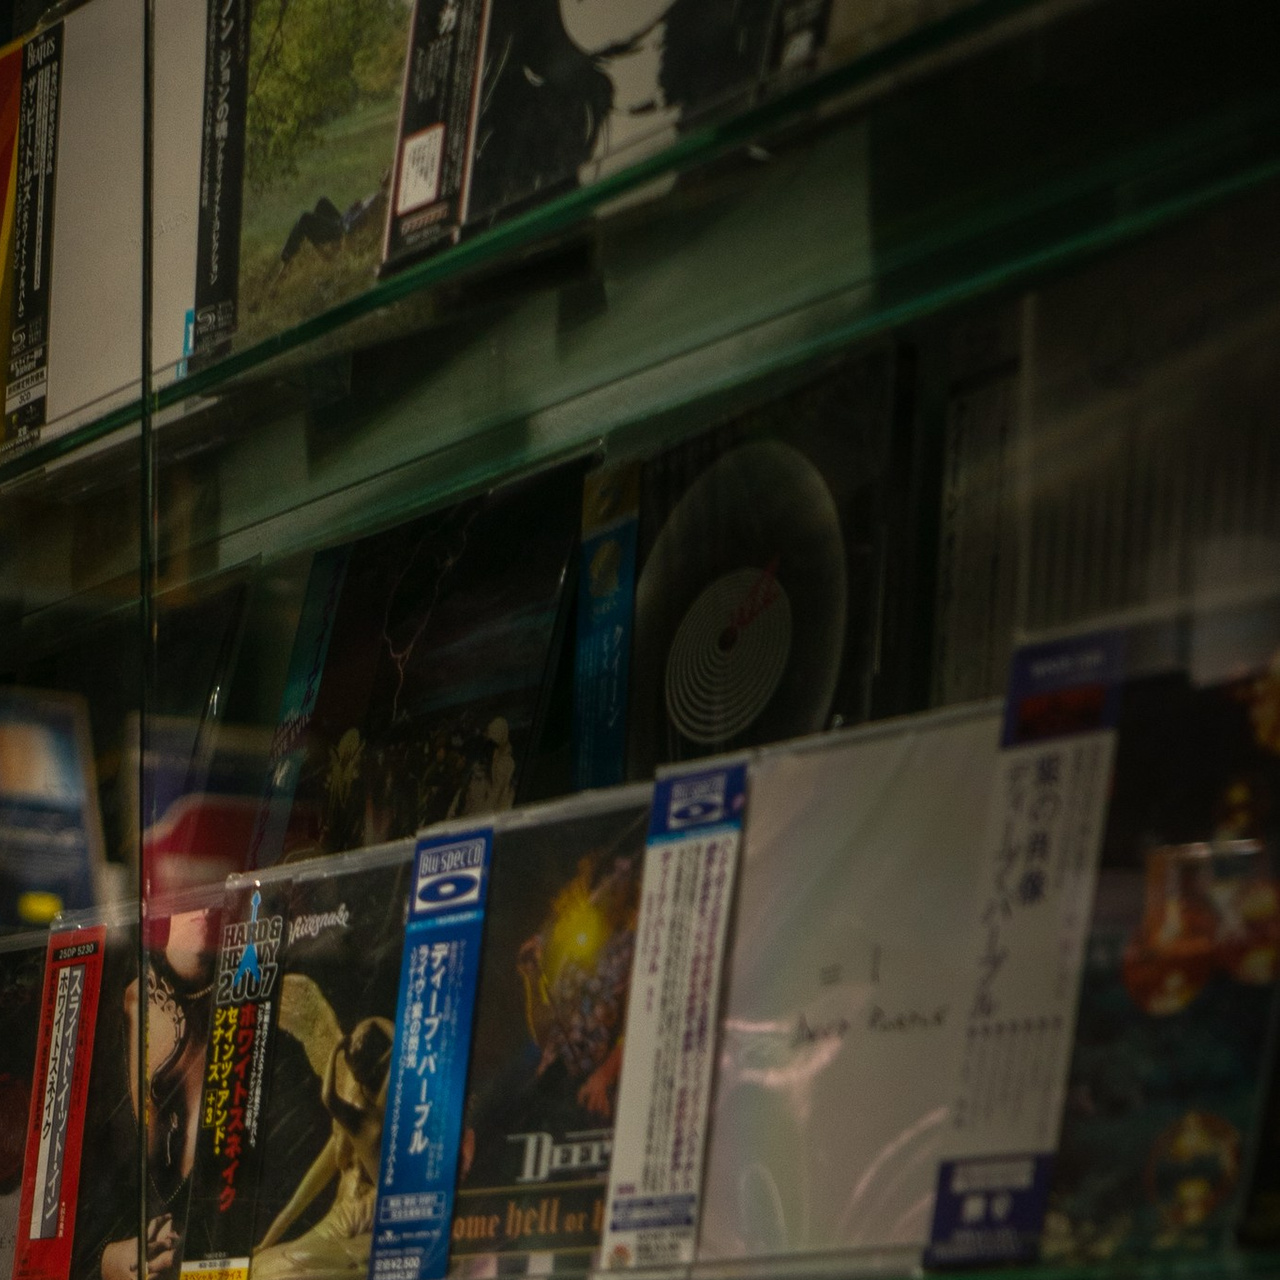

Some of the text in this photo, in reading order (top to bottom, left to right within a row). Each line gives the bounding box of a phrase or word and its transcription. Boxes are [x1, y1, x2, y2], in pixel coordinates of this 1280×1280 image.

[216, 962, 279, 1004] 2007
[220, 939, 280, 972] HEVY
[42, 973, 70, 1140] ホワイトスネイク
[45, 969, 84, 1220] スライド・イット・イン
[207, 1009, 228, 1083] シナーズ
[218, 1002, 258, 1213] ホワイトスネイク
[407, 941, 451, 1156] ディープ・パープル
